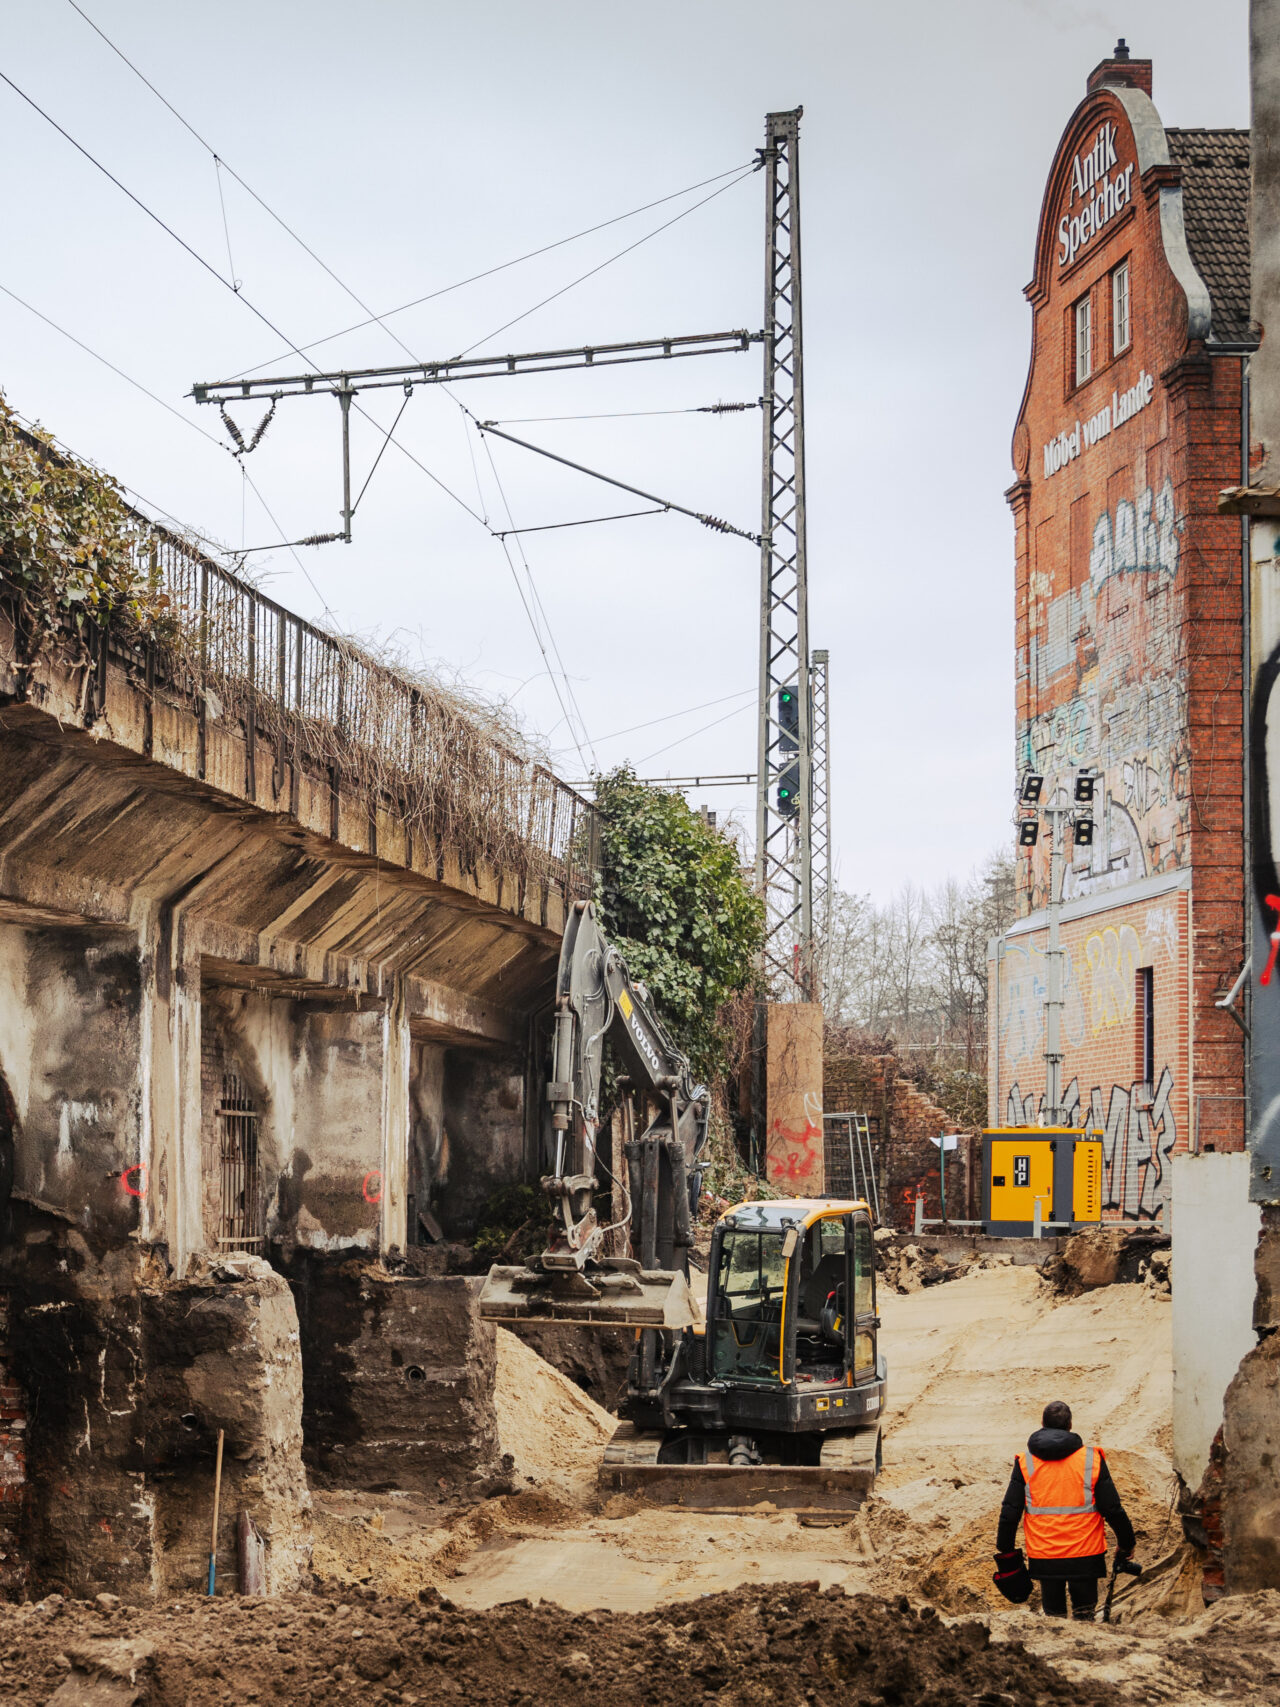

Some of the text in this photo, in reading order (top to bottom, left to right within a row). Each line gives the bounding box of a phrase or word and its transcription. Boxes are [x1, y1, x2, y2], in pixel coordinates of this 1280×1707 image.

[1069, 121, 1118, 207] Antik
[1058, 162, 1134, 266] Speicher
[1043, 369, 1154, 480] Möbel vom Lande
[631, 1013, 659, 1070] VOLVO
